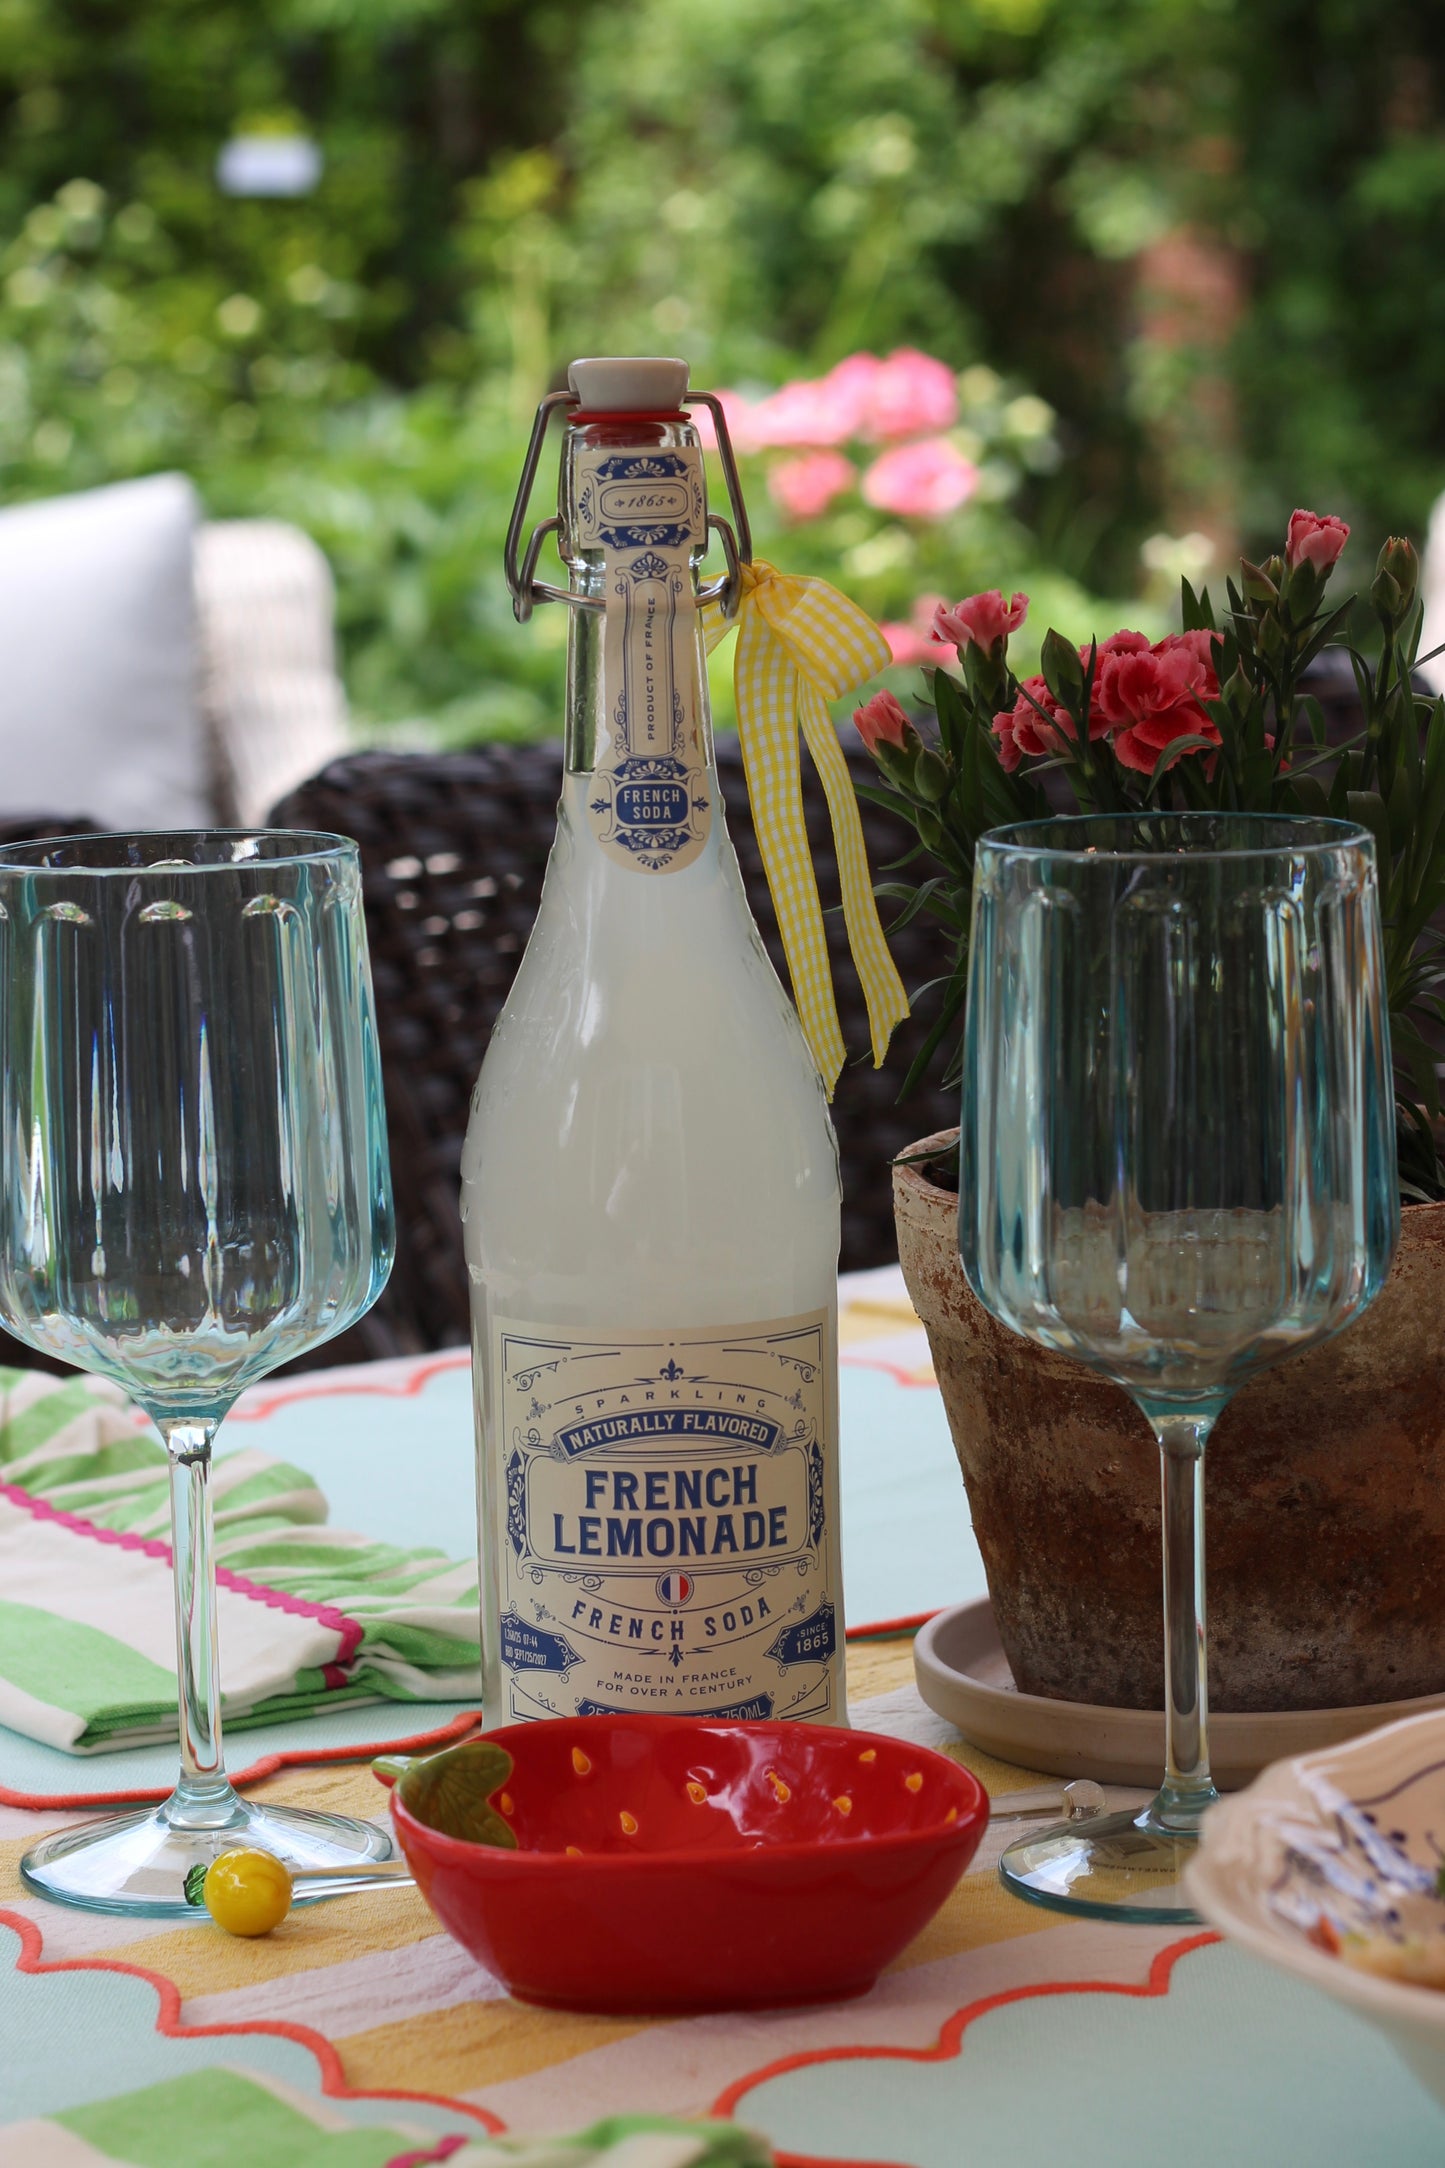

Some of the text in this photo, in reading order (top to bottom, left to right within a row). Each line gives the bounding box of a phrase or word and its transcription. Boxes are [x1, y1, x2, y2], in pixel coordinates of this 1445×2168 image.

[627, 494, 666, 508] 1865
[644, 597, 656, 741] PRODUCT OF FRANCE
[623, 789, 680, 803] FRENCH
[633, 805, 671, 819] SODA
[575, 1389, 766, 1415] SPARKLING
[569, 1413, 769, 1450] NATURALLY FLAVORED
[585, 1464, 758, 1511] FRENCH
[553, 1505, 788, 1558] LEMONADE
[571, 1597, 771, 1641] FRENCH SODA
[800, 1622, 826, 1637] SINCE
[796, 1631, 829, 1654] 1865
[597, 1674, 753, 1697] FOR OVER A CENTURY
[613, 1667, 737, 1684] MADE IN FRANCE
